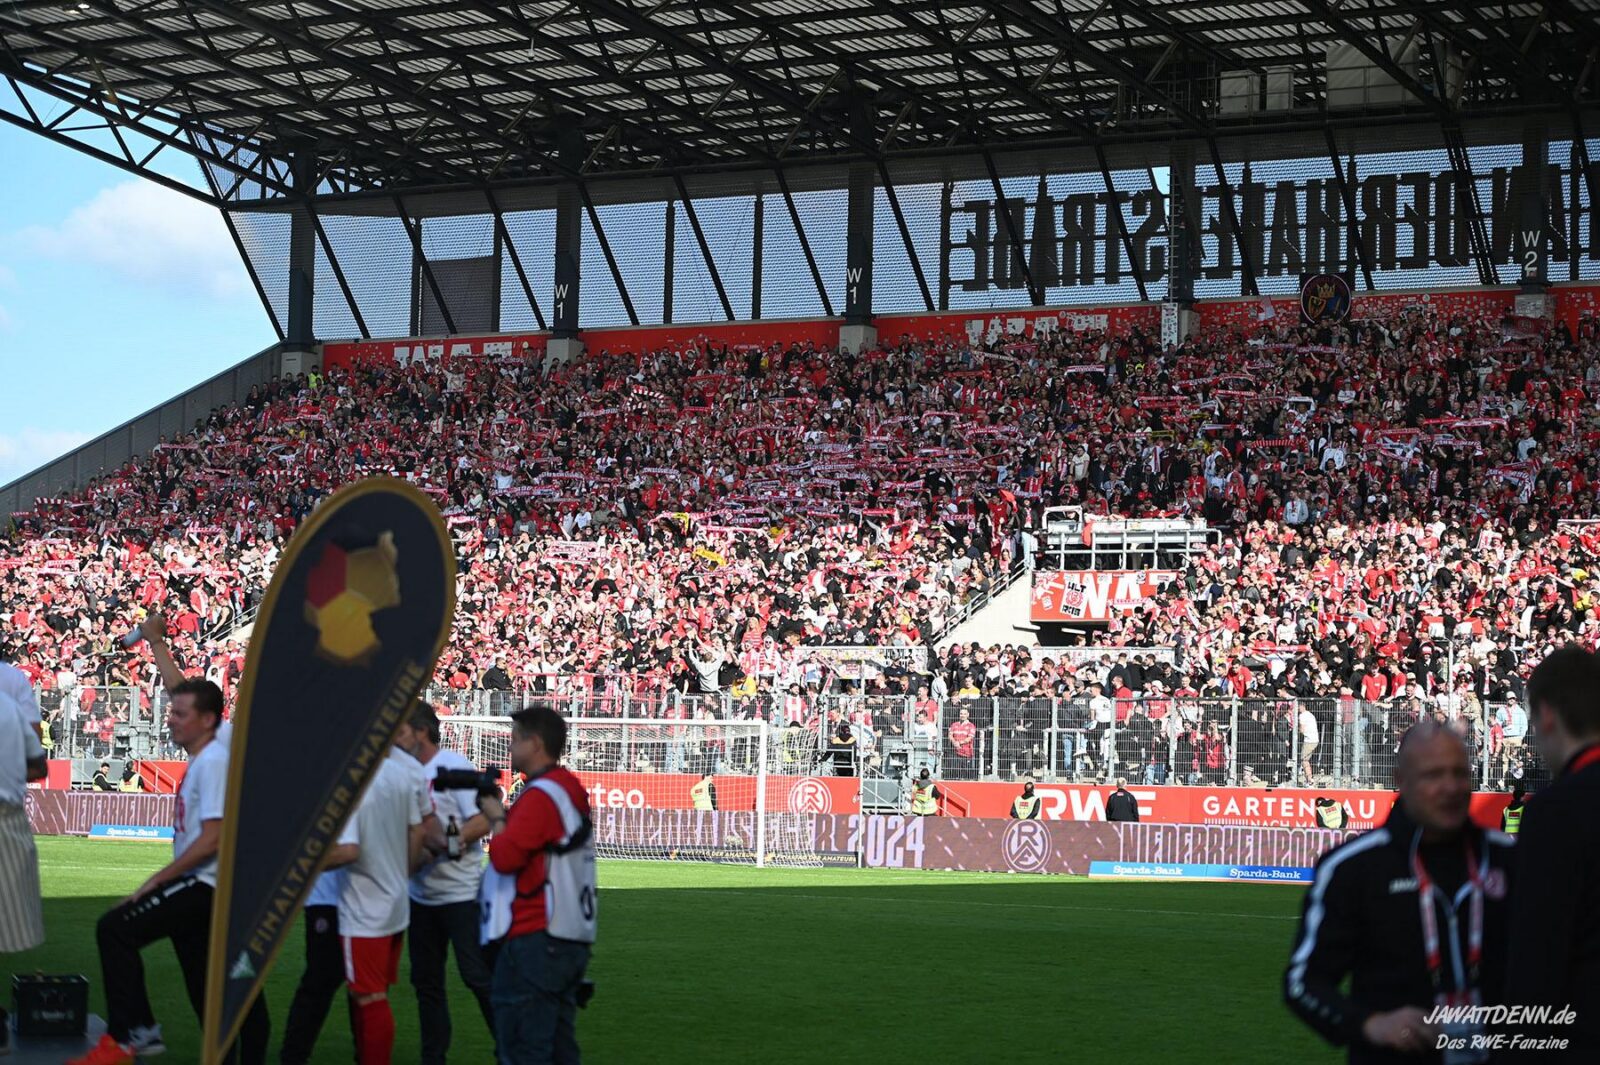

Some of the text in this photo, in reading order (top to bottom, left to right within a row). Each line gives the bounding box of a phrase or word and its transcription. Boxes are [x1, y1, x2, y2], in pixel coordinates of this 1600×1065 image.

[1522, 231, 1540, 271] W 2
[555, 284, 569, 319] W 1
[847, 268, 863, 304] W 1
[316, 787, 351, 836] DER
[347, 661, 425, 785] AMATEURE
[586, 782, 651, 809] teo.
[1203, 796, 1375, 819] GARTENAU
[848, 814, 925, 868] 2024
[1113, 865, 1183, 876] Sparda-Bank
[1230, 868, 1301, 880] Sparda-Bank
